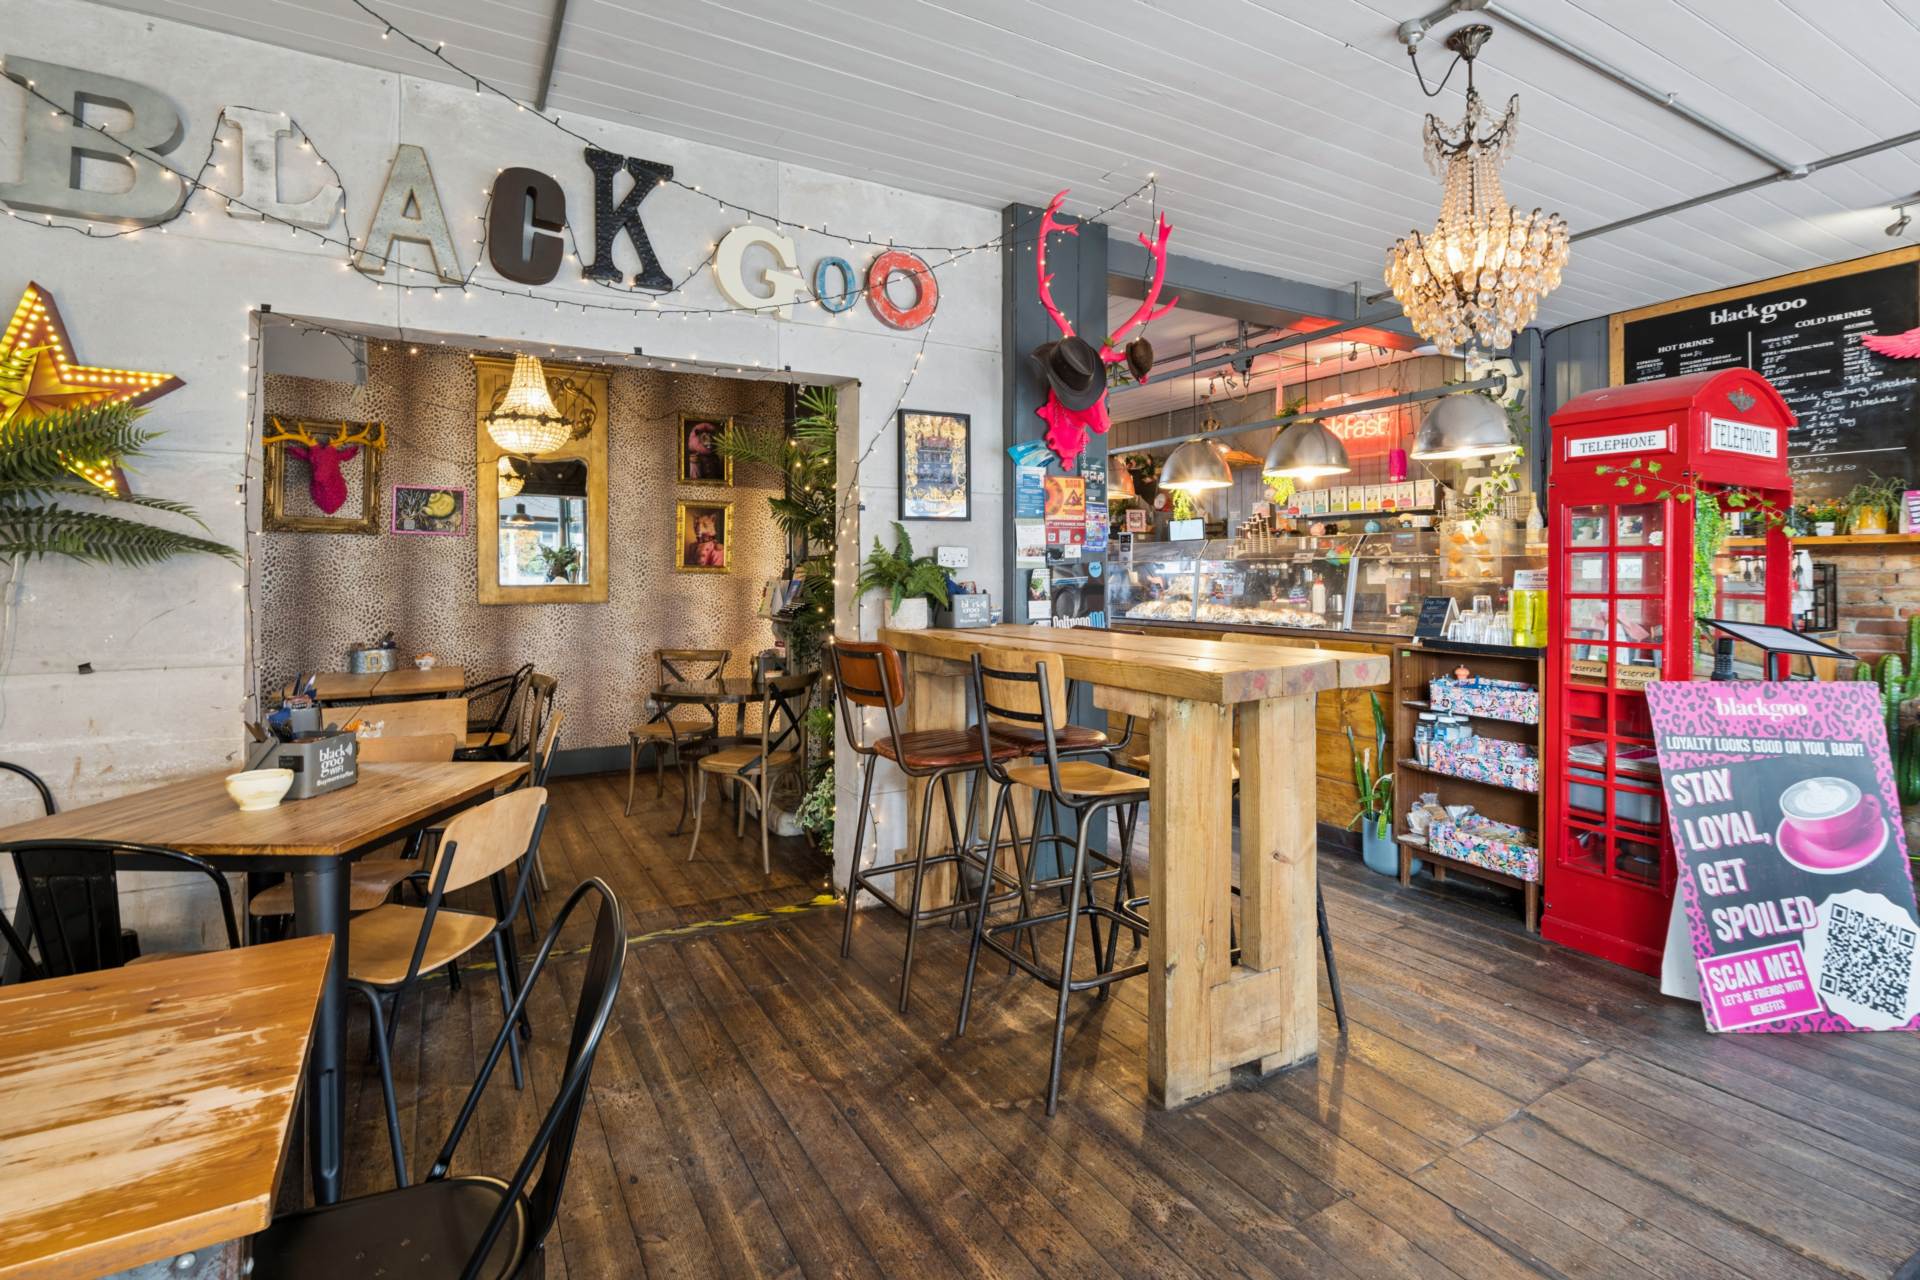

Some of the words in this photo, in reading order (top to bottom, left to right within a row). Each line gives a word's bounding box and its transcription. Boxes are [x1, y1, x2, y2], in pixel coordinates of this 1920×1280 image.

[0, 54, 673, 290] BLACK
[1795, 317, 1826, 328] COLD
[1828, 308, 1872, 323] DRINKS
[1658, 344, 1678, 354] HOT
[1680, 337, 1714, 350] DRINKS
[1326, 413, 1391, 439] kfast
[1713, 423, 1771, 454] TELEPHONE
[1579, 435, 1657, 454] TELEPHONE
[1714, 698, 1808, 722] blackgoo
[320, 744, 346, 762] black
[1666, 736, 1712, 752] LOYALTY
[1715, 737, 1751, 753] LOOKS
[1753, 739, 1783, 754] GOOD
[1785, 740, 1801, 755] ON
[1803, 741, 1829, 757] YOU,
[1832, 742, 1864, 757] BABY!
[321, 757, 345, 779] goo
[1671, 768, 1733, 807] STAY
[1684, 811, 1772, 851] LOYAL,
[1697, 858, 1750, 897] GET
[1711, 896, 1819, 944] SPOILED
[1709, 959, 1763, 993] SCAN
[1763, 950, 1803, 982] ME!
[1784, 980, 1806, 993] WITH
